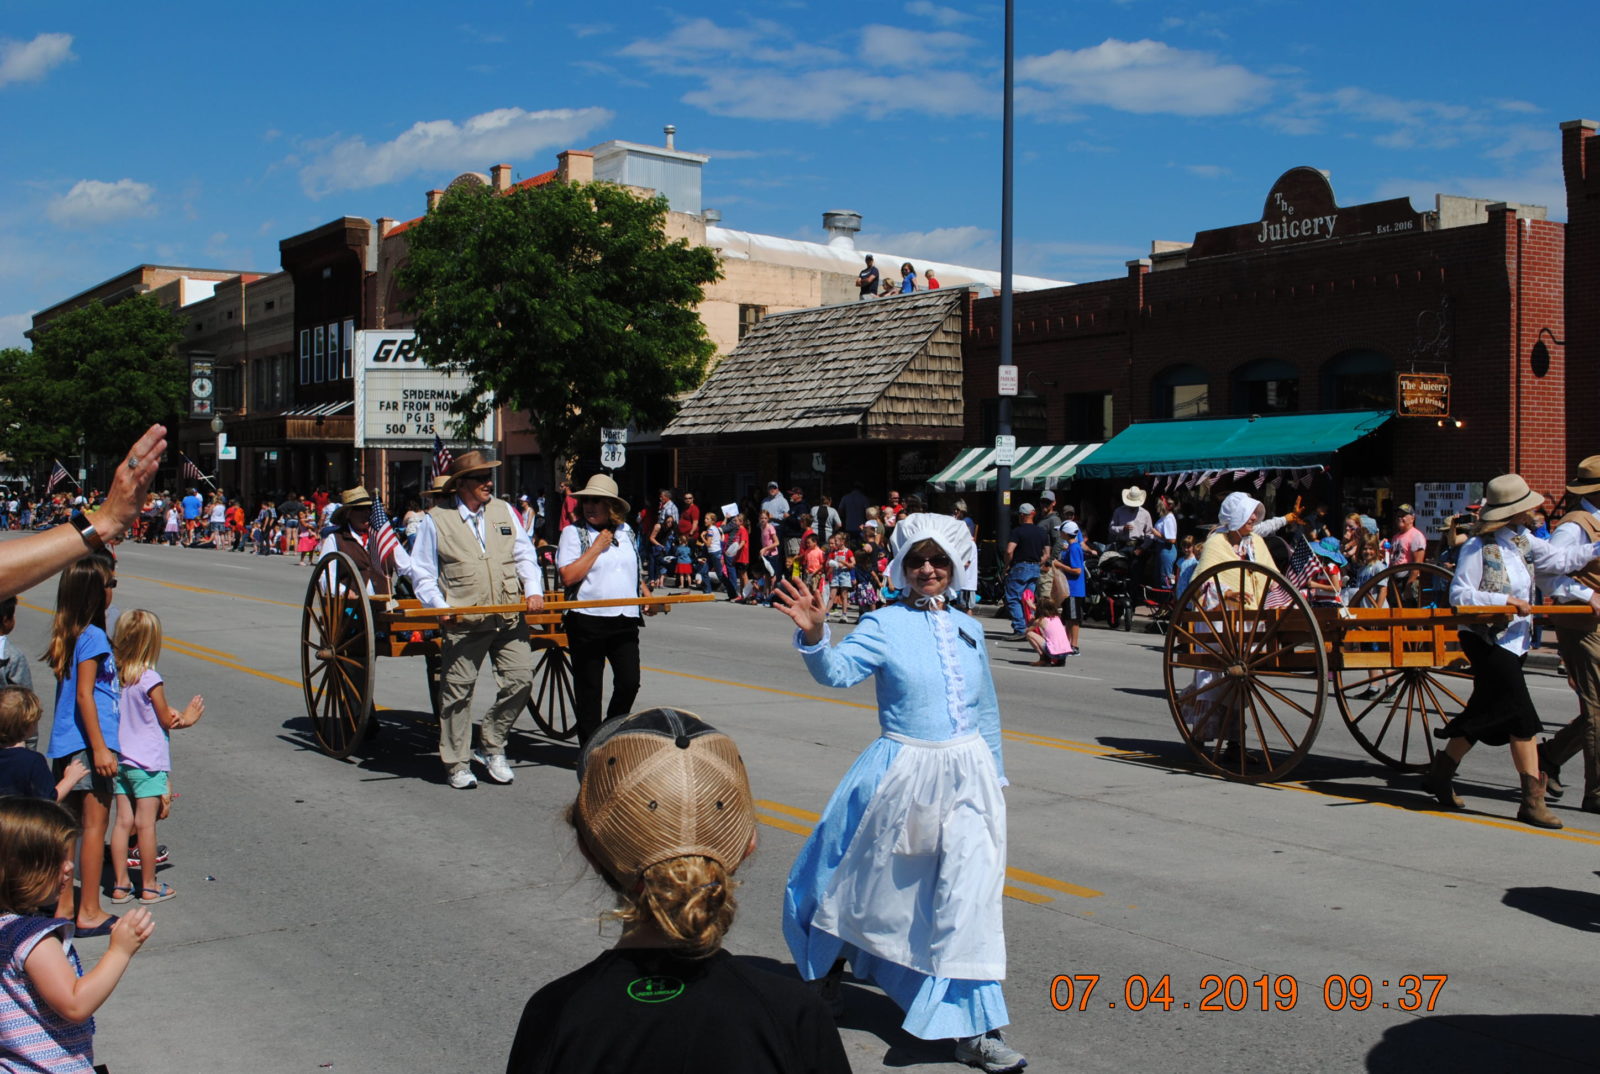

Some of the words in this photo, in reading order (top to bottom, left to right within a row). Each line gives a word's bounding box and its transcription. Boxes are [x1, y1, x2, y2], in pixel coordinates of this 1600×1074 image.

[1274, 192, 1294, 216] The
[1257, 214, 1339, 243] Juicery
[1377, 225, 1393, 235] Est.
[1394, 220, 1413, 231] 2016
[1401, 381, 1416, 390] The
[1419, 381, 1448, 394] Juicery
[379, 401, 399, 411] FAR
[403, 401, 430, 411] FROM
[425, 412, 435, 423] 13
[386, 424, 406, 434] 500
[416, 424, 434, 435] 745
[602, 430, 625, 440] NORTH
[604, 451, 622, 462] 287
